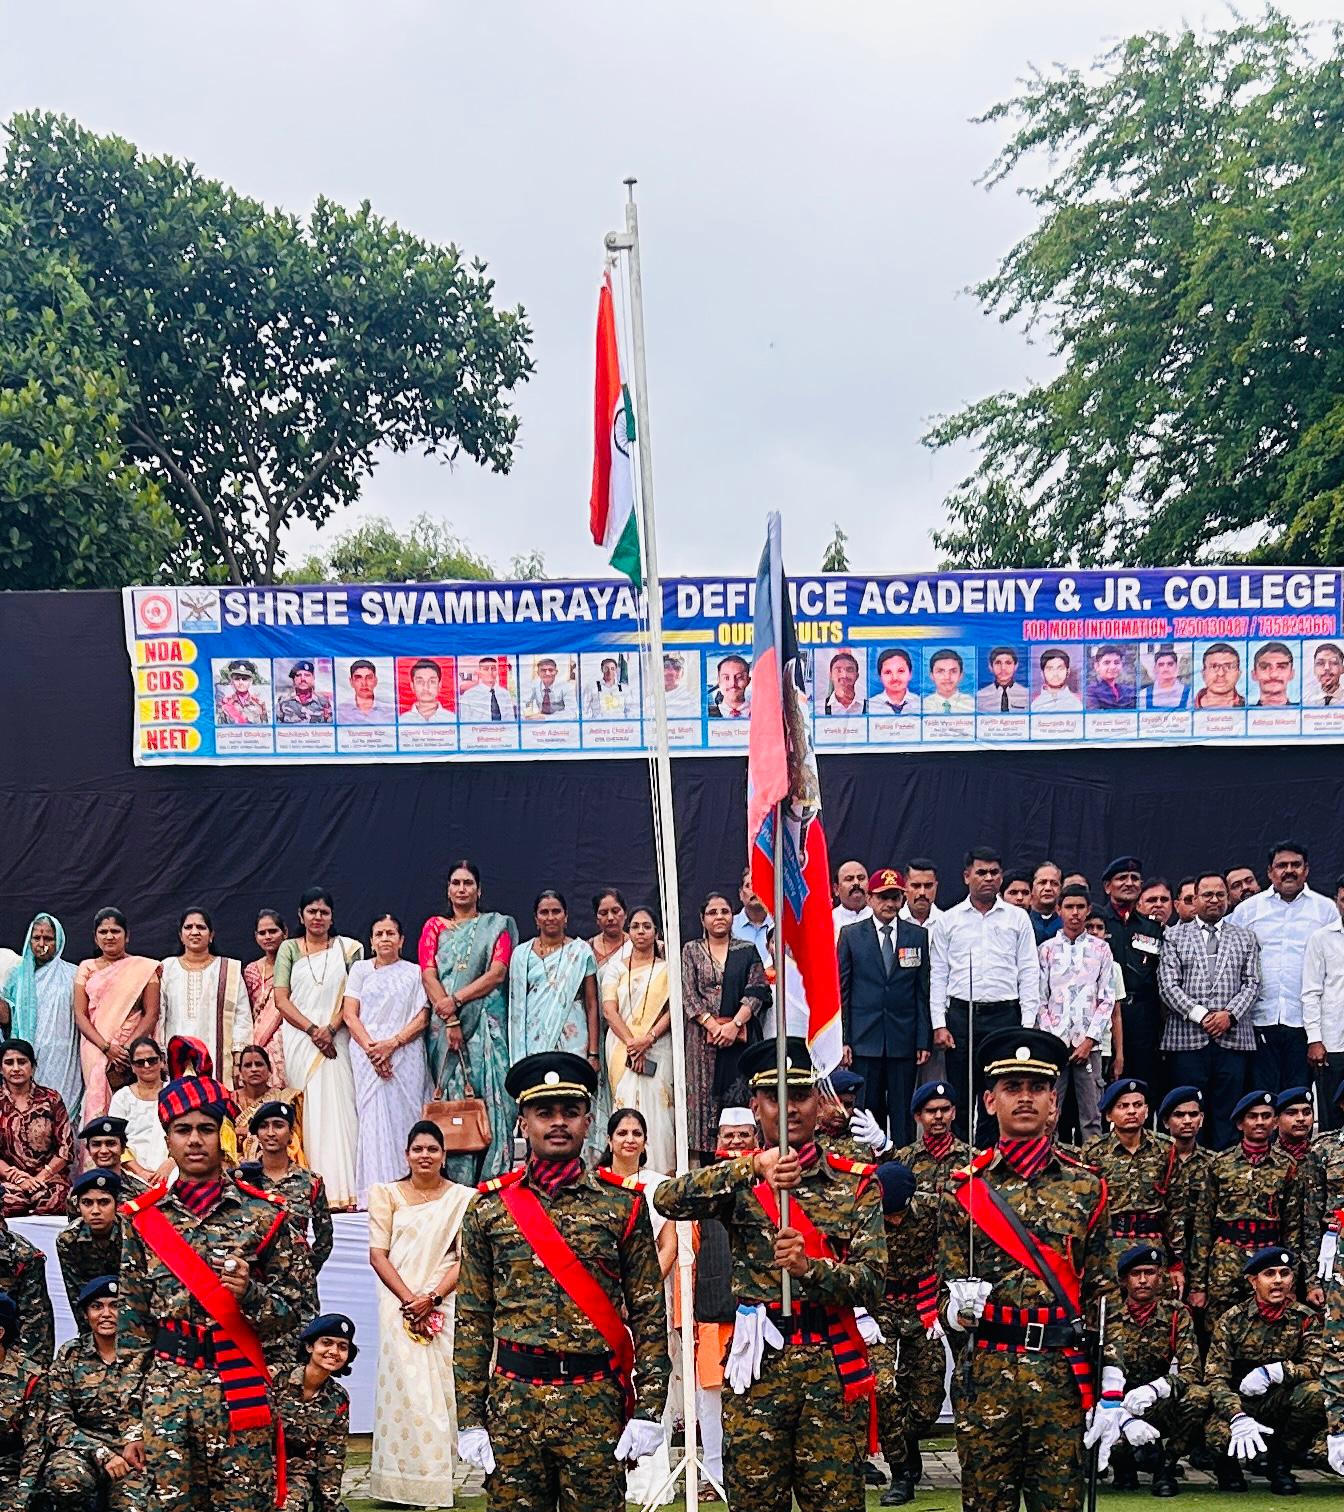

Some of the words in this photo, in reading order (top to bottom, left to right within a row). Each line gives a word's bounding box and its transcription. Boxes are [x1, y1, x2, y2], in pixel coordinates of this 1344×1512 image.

[224, 591, 350, 626] SHREE
[677, 581, 848, 618] DEFCE
[858, 578, 1042, 615] ACADEMY
[1054, 578, 1081, 612] &
[1093, 576, 1152, 611] JR.
[1163, 573, 1337, 609] COLLEGE
[1023, 619, 1048, 640] FOR
[1048, 619, 1084, 640] MORE
[144, 640, 183, 663] NDA
[146, 669, 185, 691] CDS
[152, 699, 181, 720] JEE
[146, 728, 189, 750] NEET
